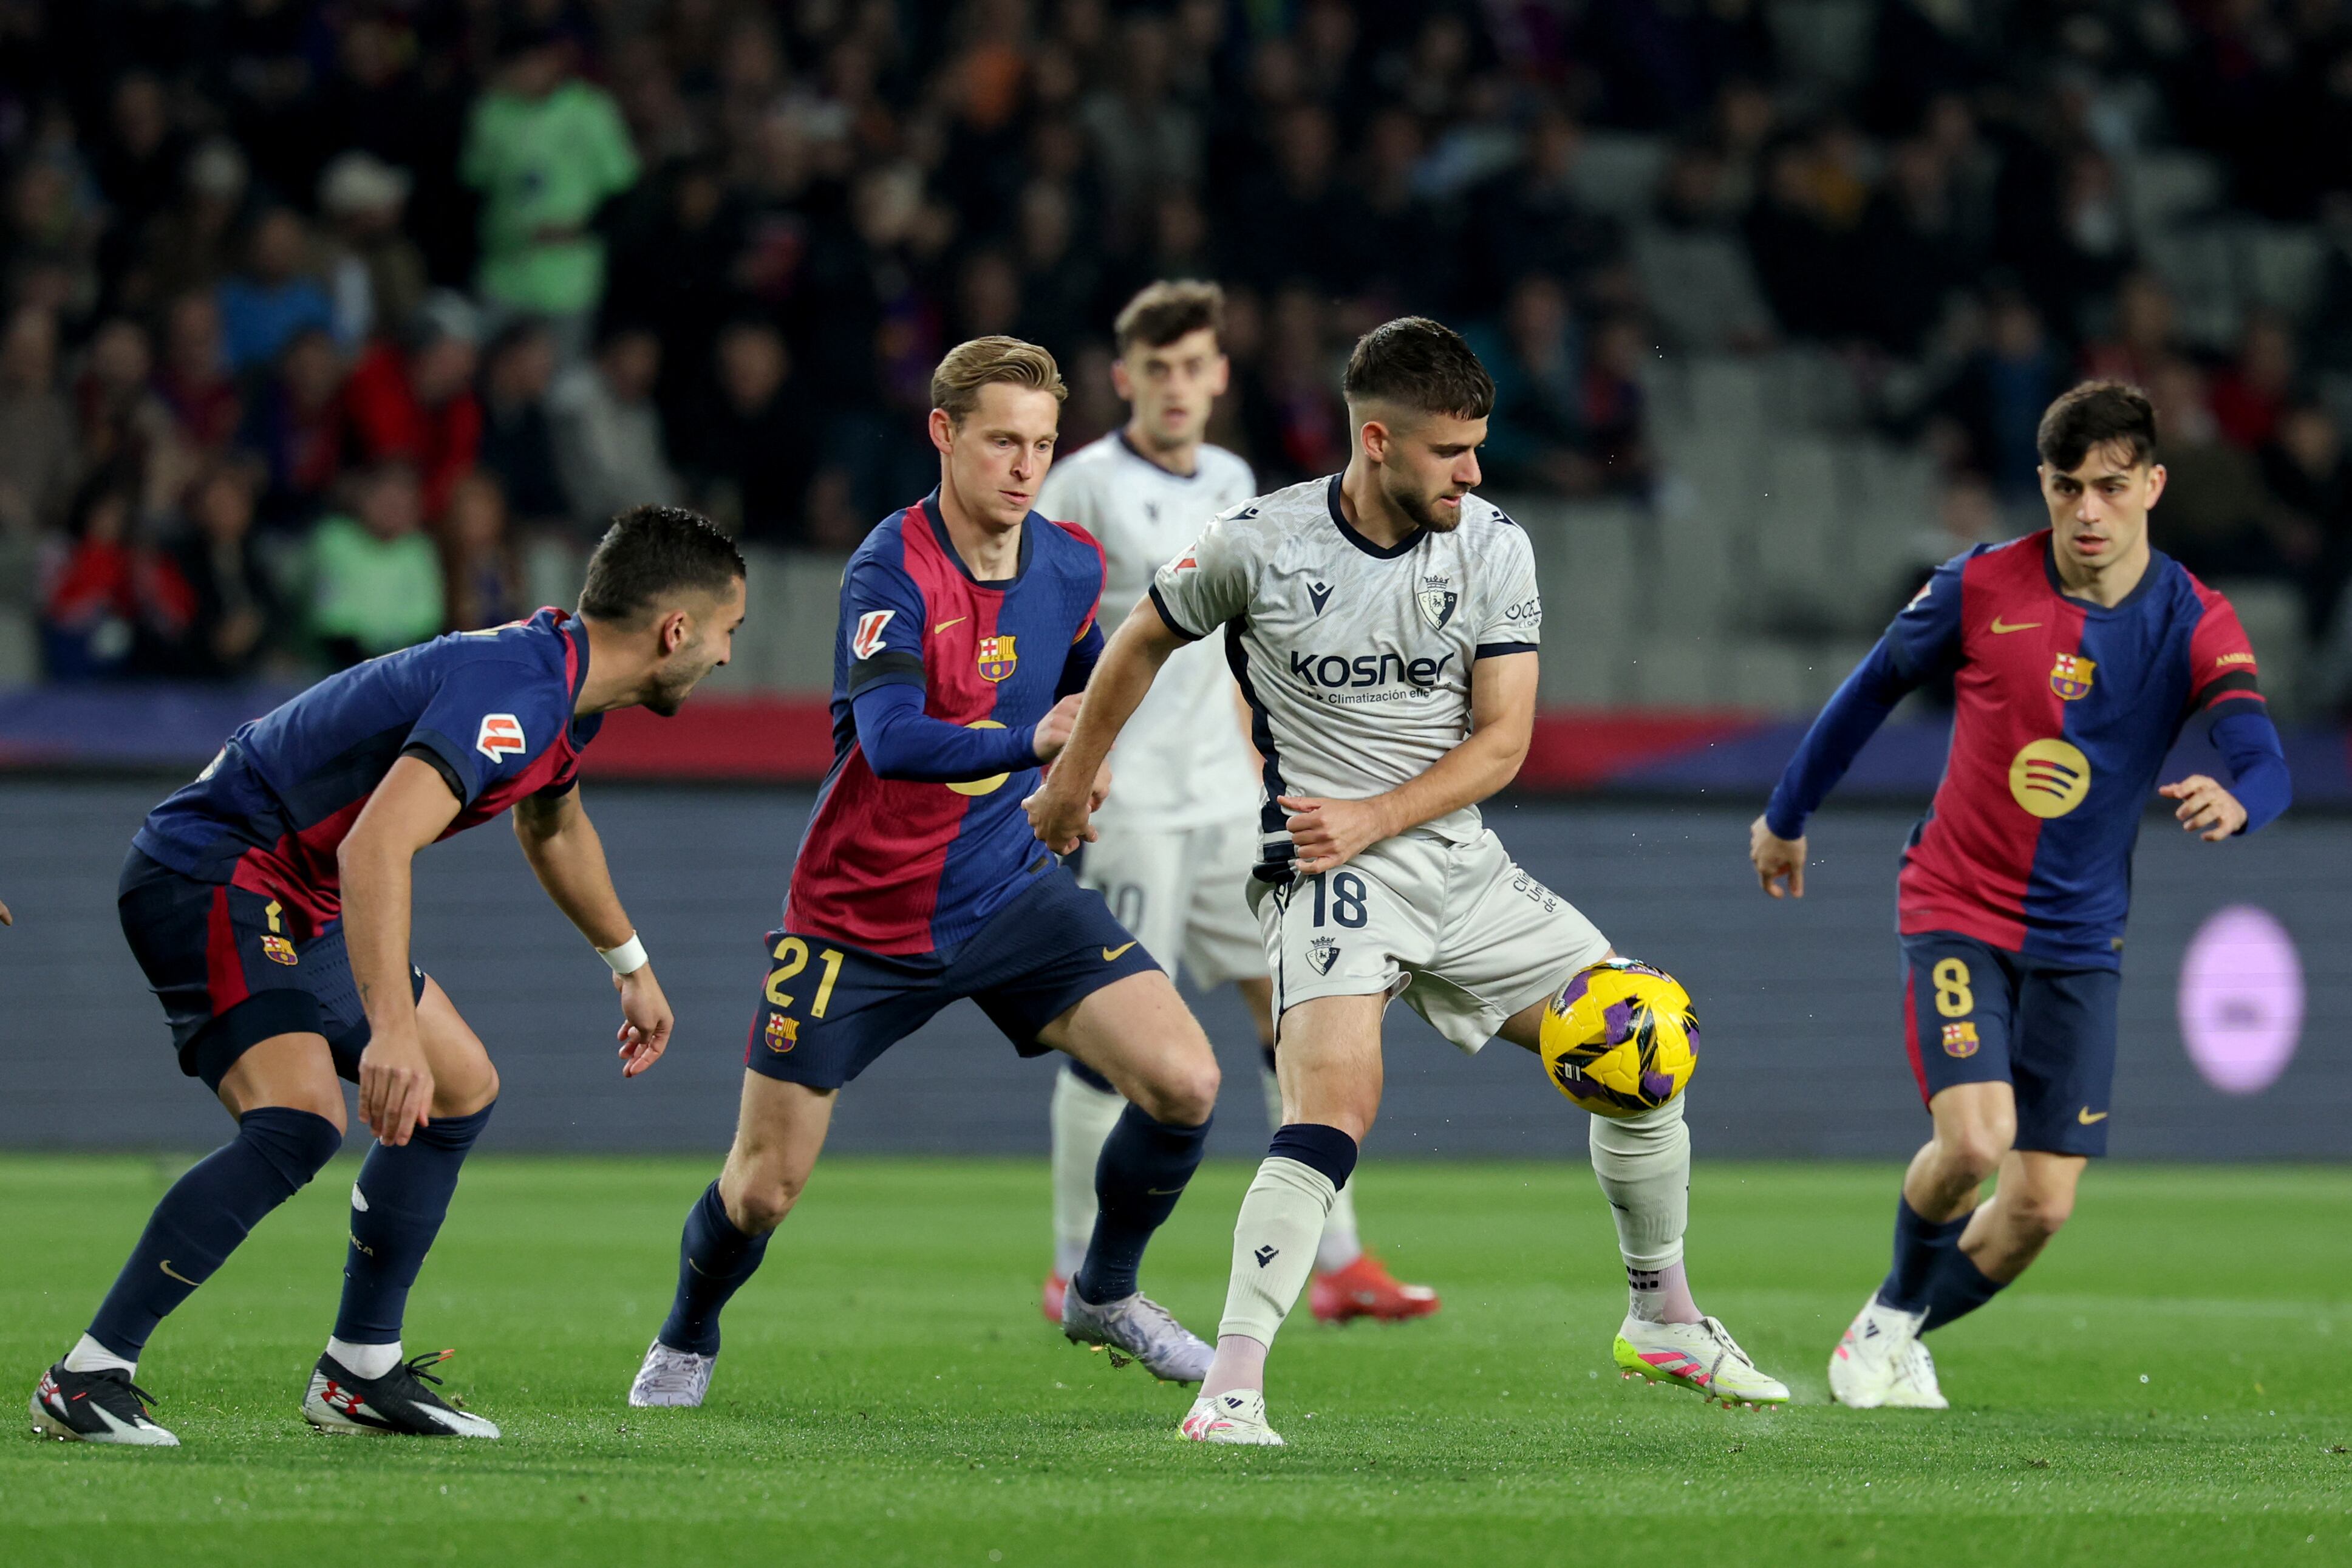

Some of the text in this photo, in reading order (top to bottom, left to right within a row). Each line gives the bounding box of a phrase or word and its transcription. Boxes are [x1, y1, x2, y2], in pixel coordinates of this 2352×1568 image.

[1328, 689, 1406, 704] Climatización
[1306, 871, 1368, 929] 18
[1543, 898, 1557, 913] de
[766, 936, 844, 1018] 21
[1933, 958, 1974, 1017] 8
